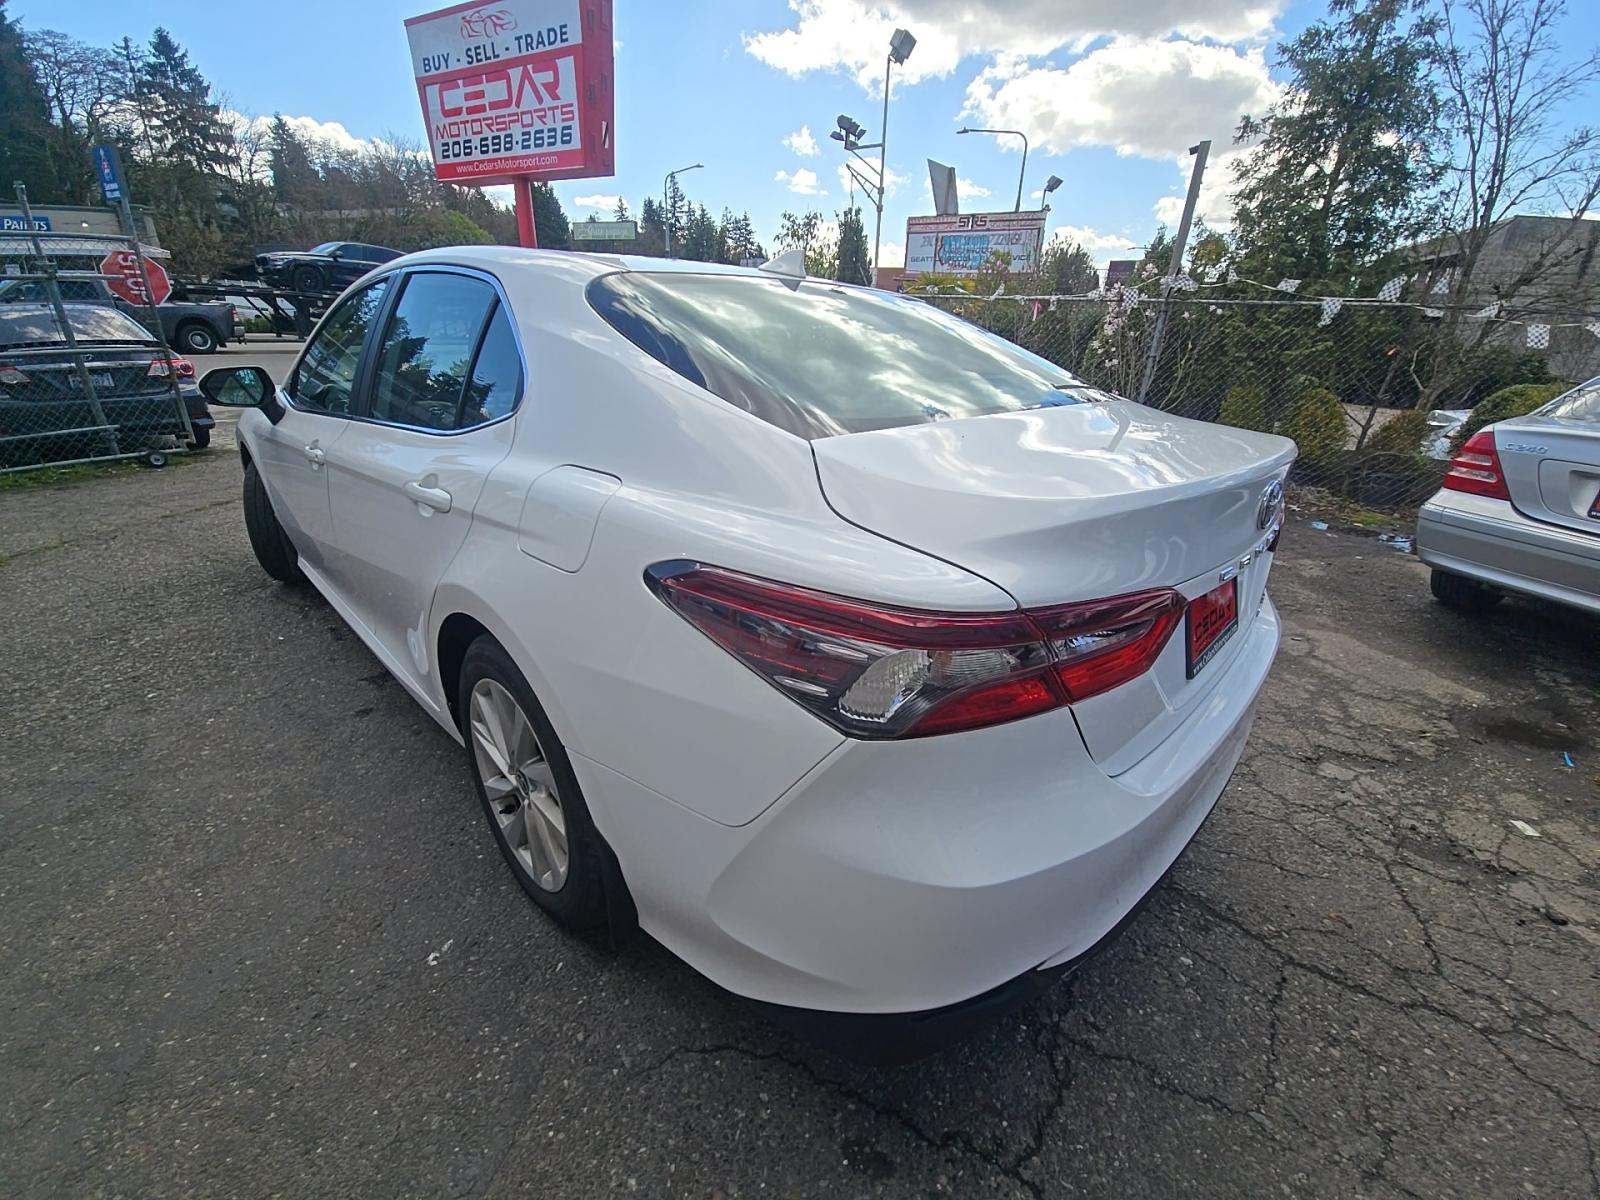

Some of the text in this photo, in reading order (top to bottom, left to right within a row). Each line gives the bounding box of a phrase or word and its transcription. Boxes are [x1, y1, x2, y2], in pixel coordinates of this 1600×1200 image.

[423, 53, 450, 73] BUY
[466, 41, 500, 65] SELL
[514, 24, 569, 53] TRADE
[438, 59, 561, 118] CEDAR
[435, 103, 575, 140] MOTORSPORTS
[455, 155, 558, 173] www.CedarsMotorsport.com
